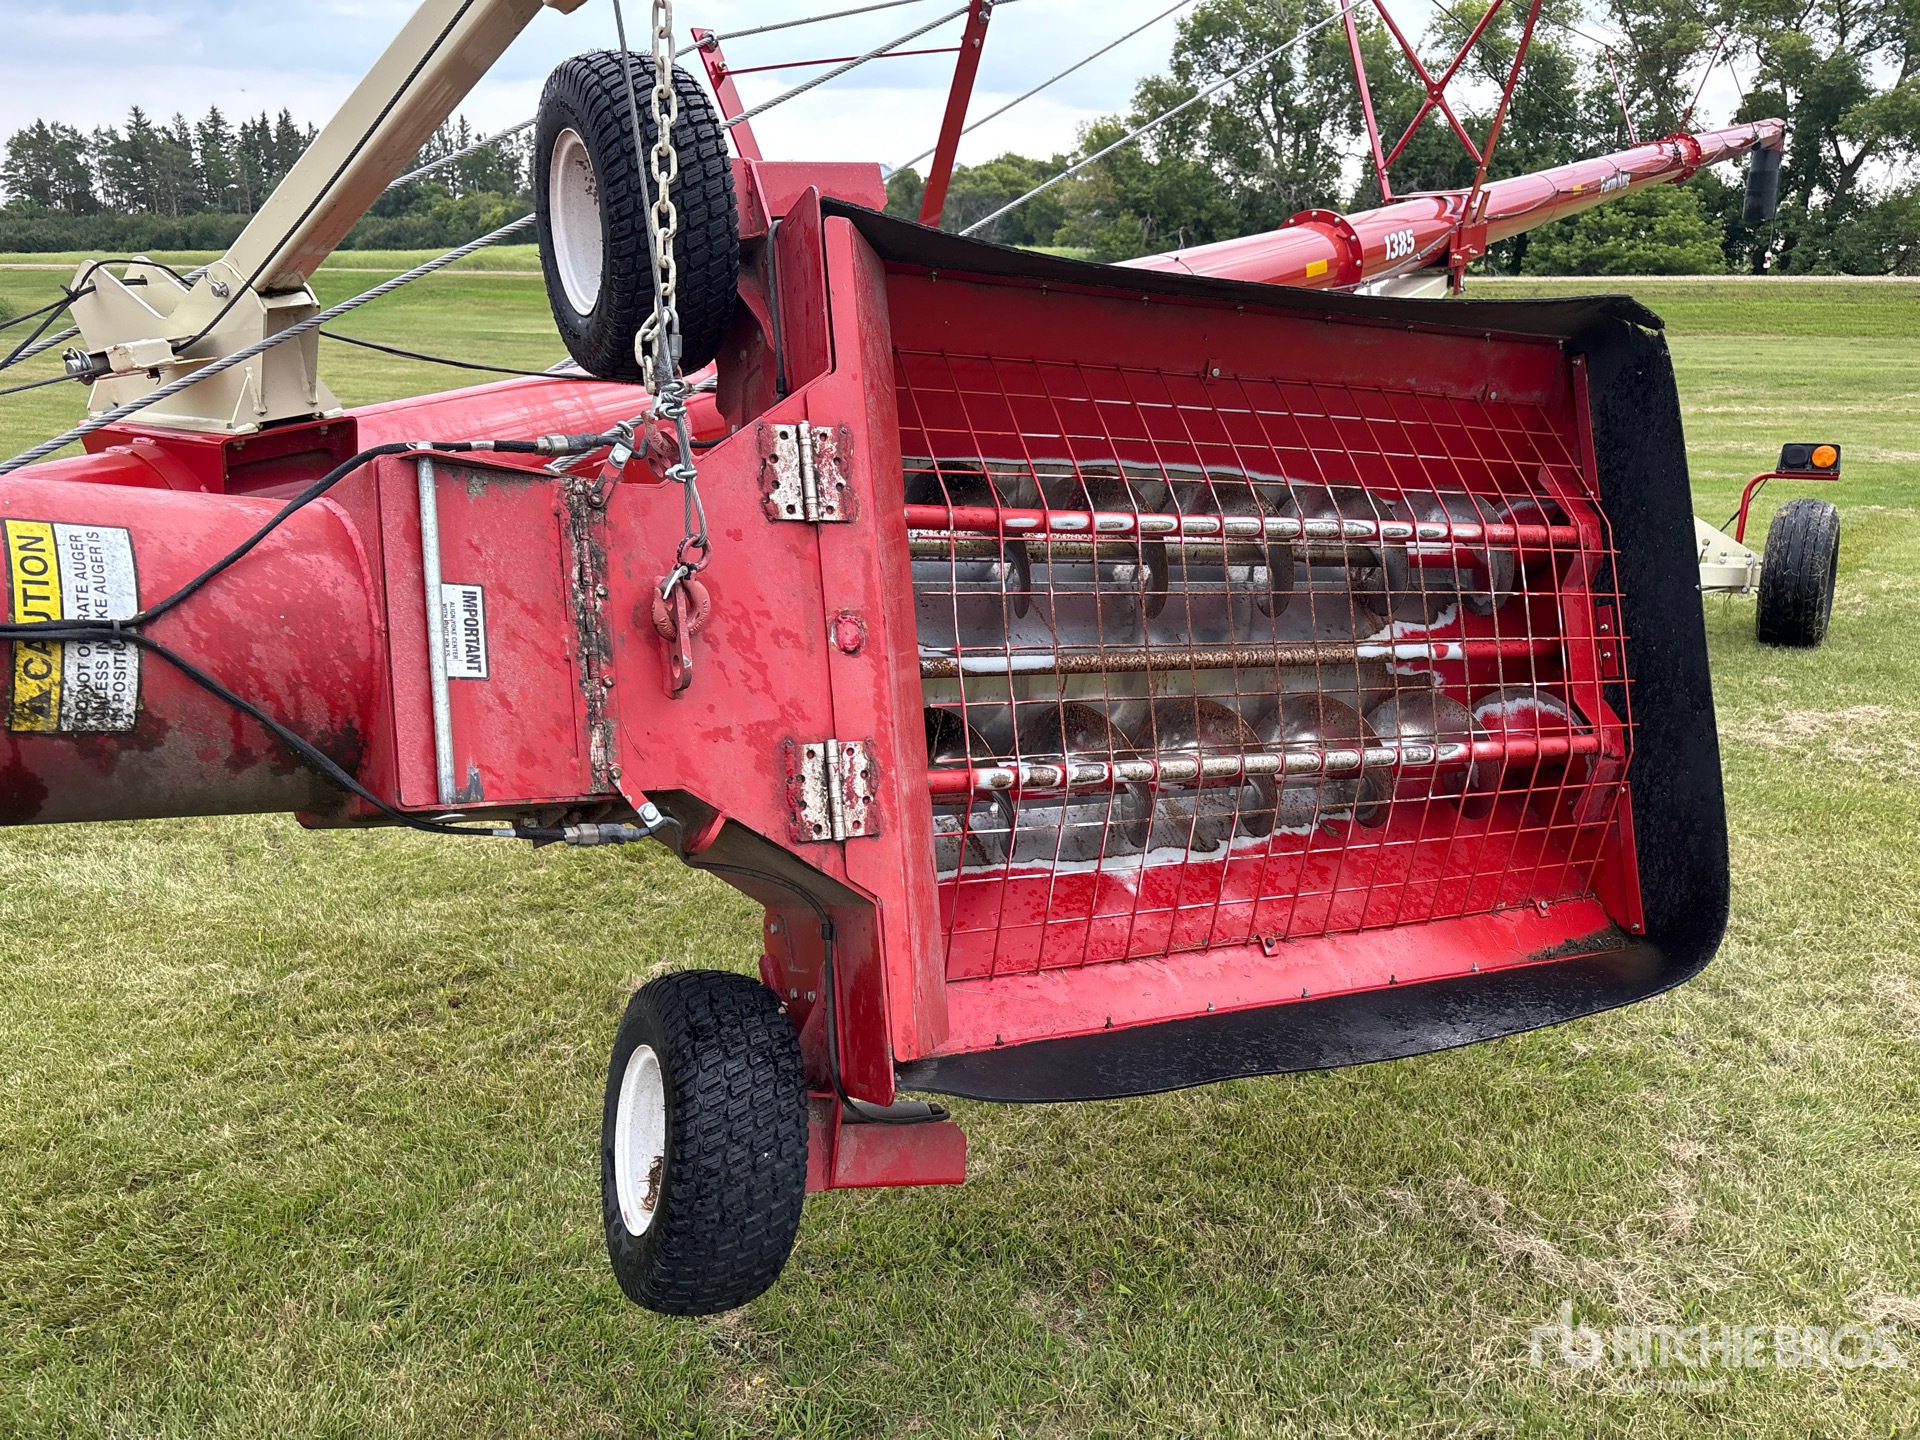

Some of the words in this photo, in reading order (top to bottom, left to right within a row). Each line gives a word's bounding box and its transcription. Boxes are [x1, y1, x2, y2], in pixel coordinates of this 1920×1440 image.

[1384, 228, 1415, 261] 1385
[86, 531, 101, 543] IS
[69, 534, 88, 581] AUGER
[89, 546, 107, 595] AUGER
[94, 598, 109, 655] INKE
[449, 601, 457, 619] ALIGN
[450, 619, 458, 636] YOKE
[451, 637, 459, 660] CENTER
[461, 590, 482, 673] IMPORTANT
[112, 638, 127, 703] POSITIO
